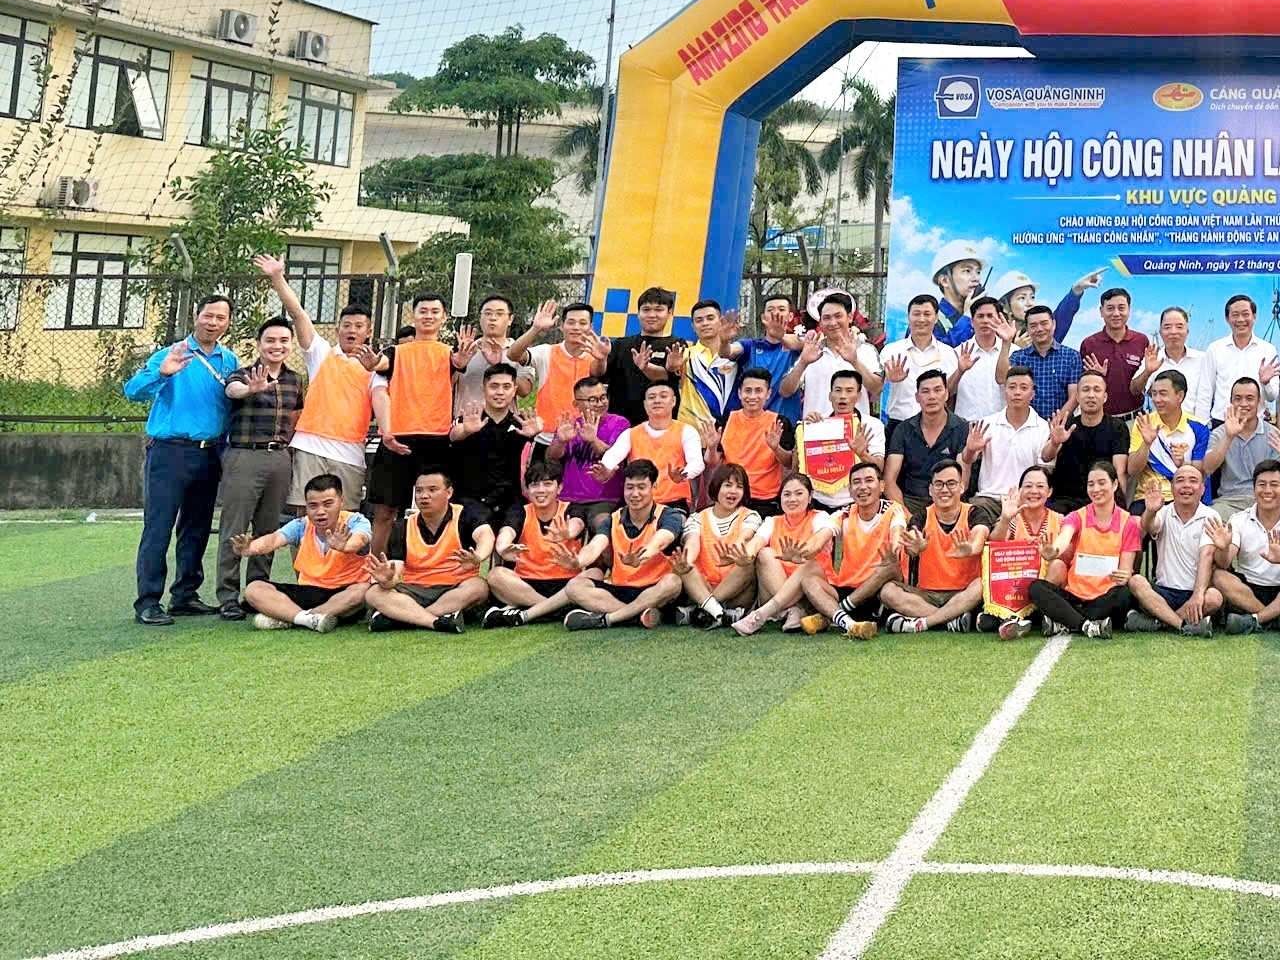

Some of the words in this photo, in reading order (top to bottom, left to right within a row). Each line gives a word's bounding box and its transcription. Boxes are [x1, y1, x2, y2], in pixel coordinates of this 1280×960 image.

[677, 0, 769, 86] AMAZING
[956, 93, 973, 101] VOSA
[986, 88, 1022, 101] VOSA
[1025, 84, 1071, 102] QUẢNG
[1073, 88, 1104, 100] NINH
[1210, 85, 1246, 100] CẢNG
[931, 131, 1015, 180] NGÀY
[1023, 131, 1073, 186] HỘI
[1082, 131, 1163, 178] CÔNG
[1172, 131, 1255, 177] NHÂN
[1126, 189, 1164, 204] KHU
[1169, 186, 1207, 208] VỰC
[1212, 184, 1277, 206] QUẢNG
[1060, 214, 1084, 227] CHÀO
[1086, 214, 1112, 227] MỪNG
[1114, 215, 1129, 229] ĐẠI
[1132, 213, 1146, 228] HỘI
[1148, 213, 1173, 226] CÔNG
[1175, 214, 1200, 226] ĐOÀN
[1201, 213, 1221, 228] VIỆT
[1223, 215, 1242, 226] NAM
[1244, 212, 1262, 226] LẦN
[1046, 230, 1064, 244] ỨNG
[1104, 230, 1128, 243] CÔNG
[1200, 230, 1224, 243] HÀNH
[1227, 230, 1252, 245] ĐỘNG
[1254, 228, 1264, 242] VỀ
[1266, 232, 1278, 242] AN
[1143, 259, 1176, 271] Quảng
[1178, 260, 1203, 270] Ninh,
[1206, 260, 1230, 272] ngày
[1234, 260, 1245, 269] 12
[1247, 259, 1275, 271] tháng
